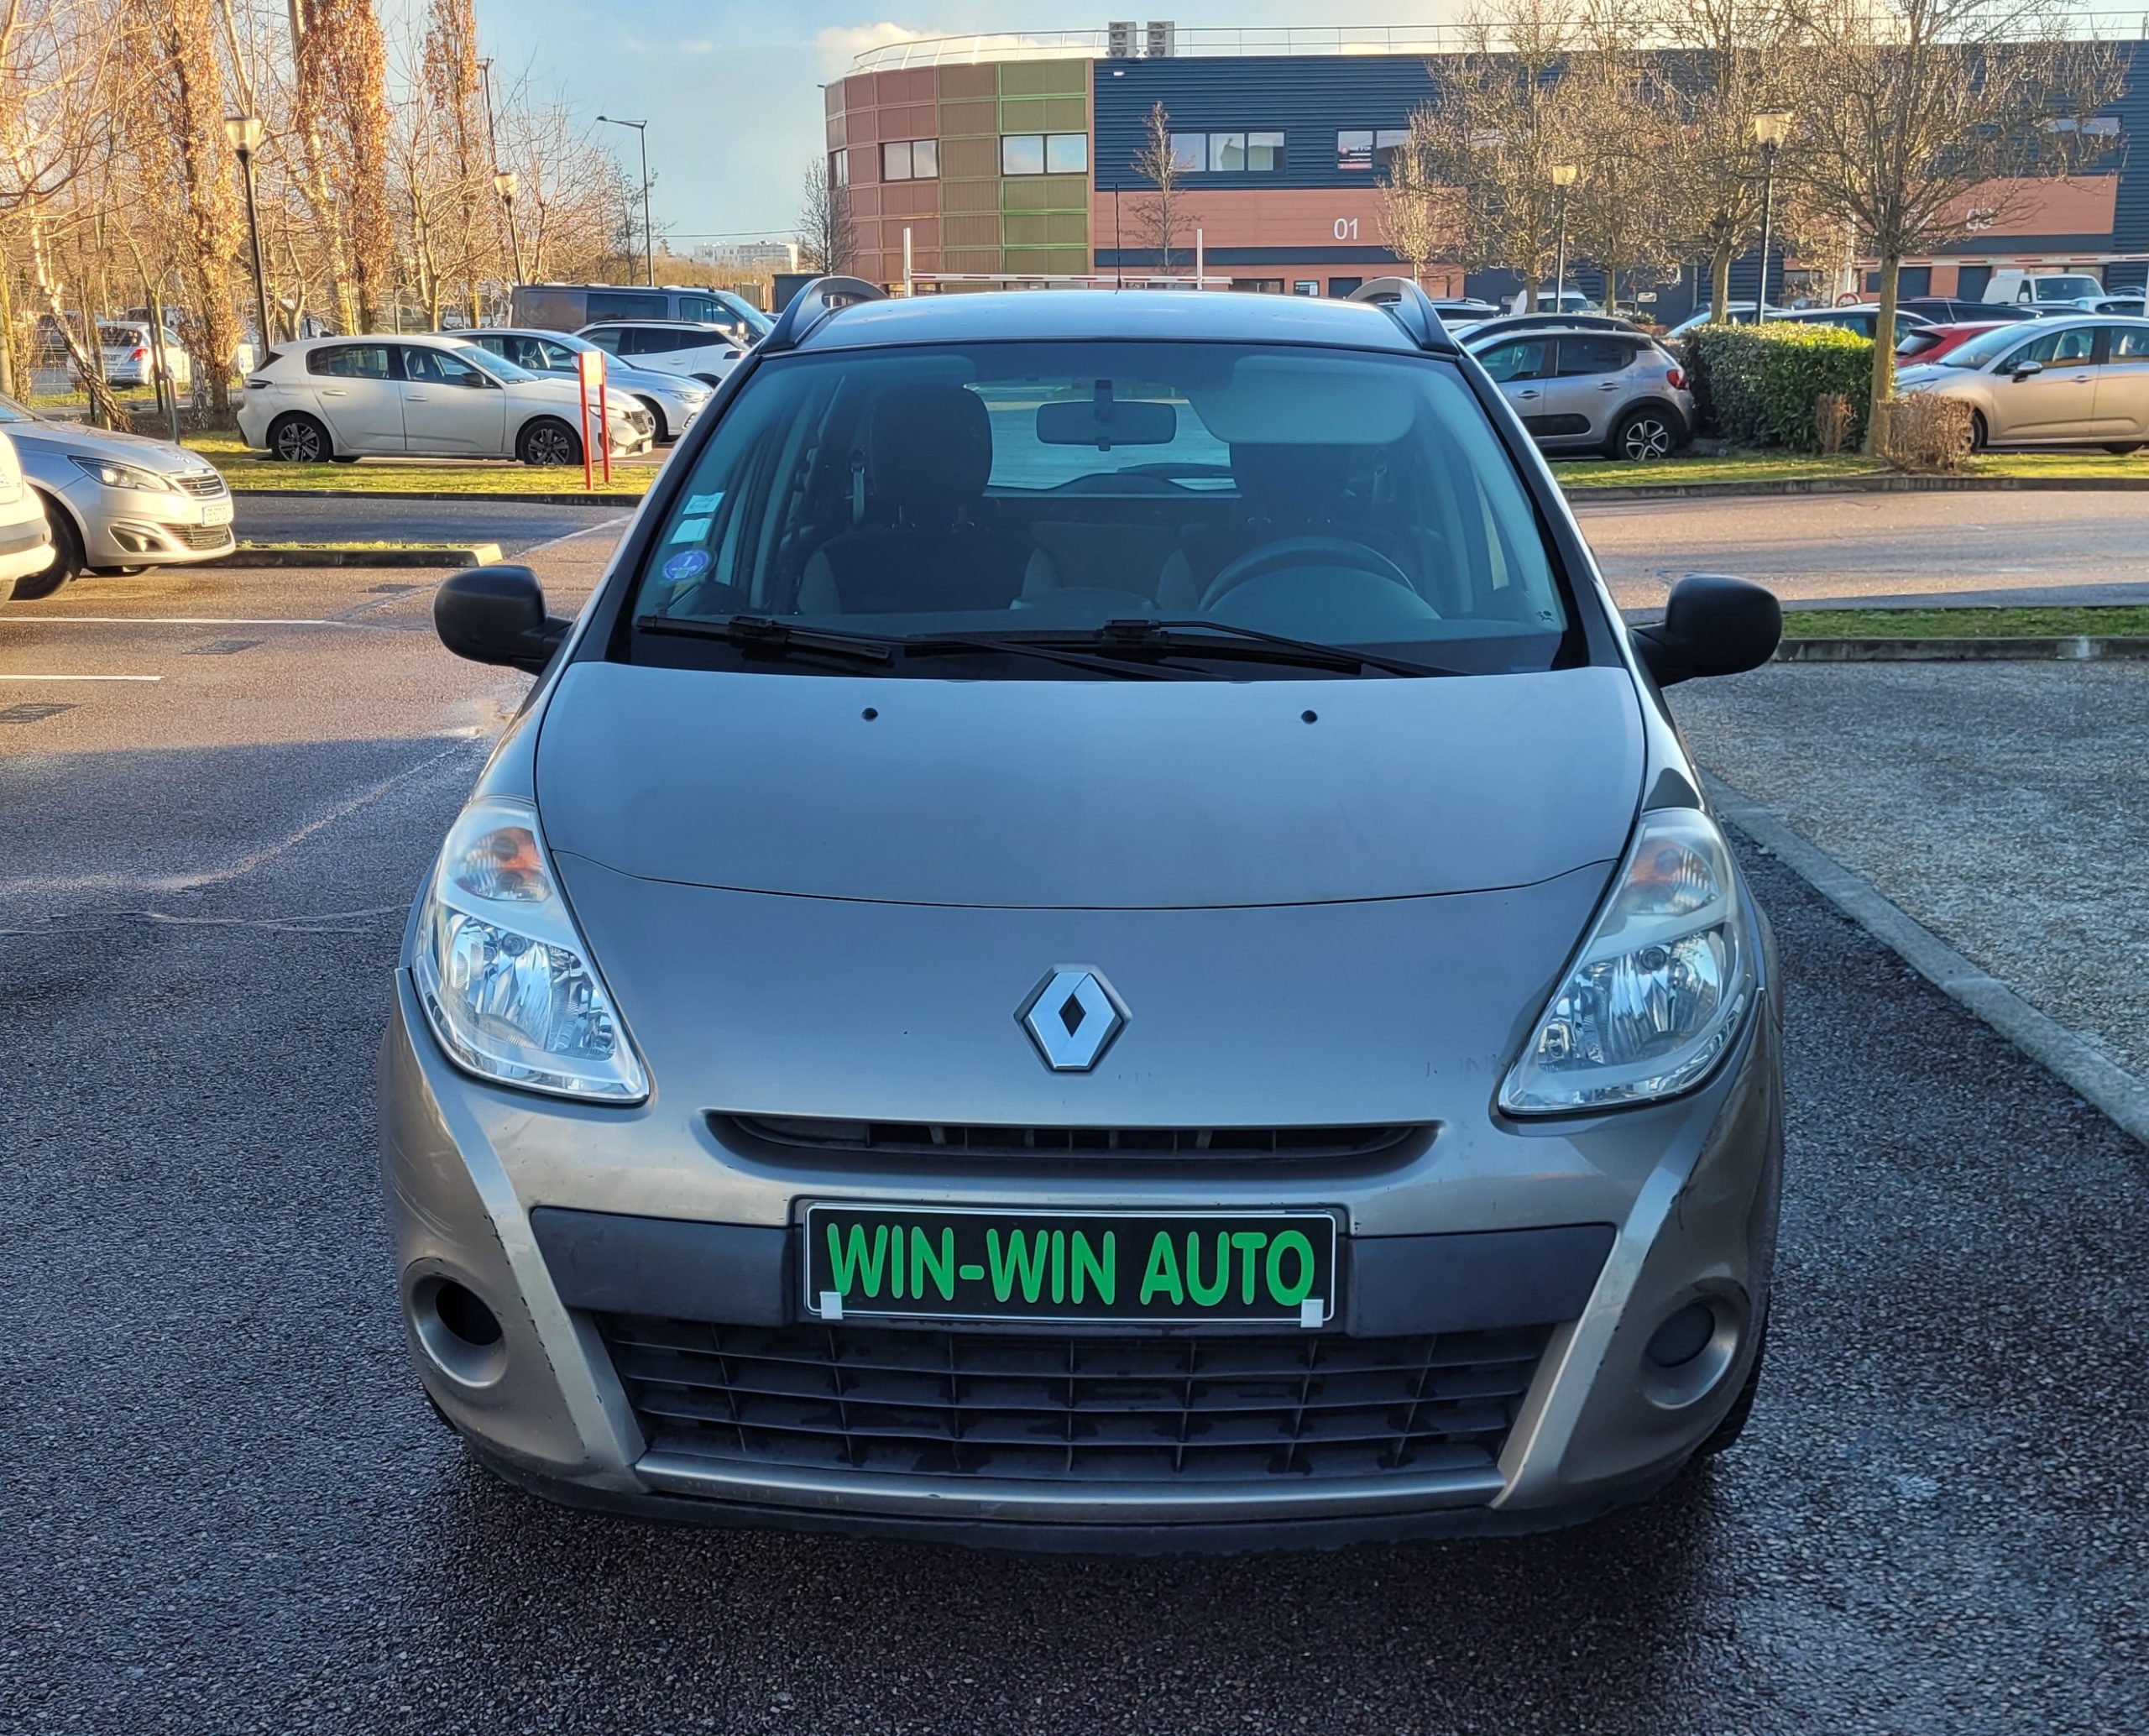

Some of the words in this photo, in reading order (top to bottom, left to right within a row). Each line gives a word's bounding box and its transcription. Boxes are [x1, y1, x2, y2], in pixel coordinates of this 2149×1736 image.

[1333, 217, 1358, 240] 01
[826, 1222, 1116, 1305] WIN-WIN
[1140, 1229, 1315, 1306] AUTO
